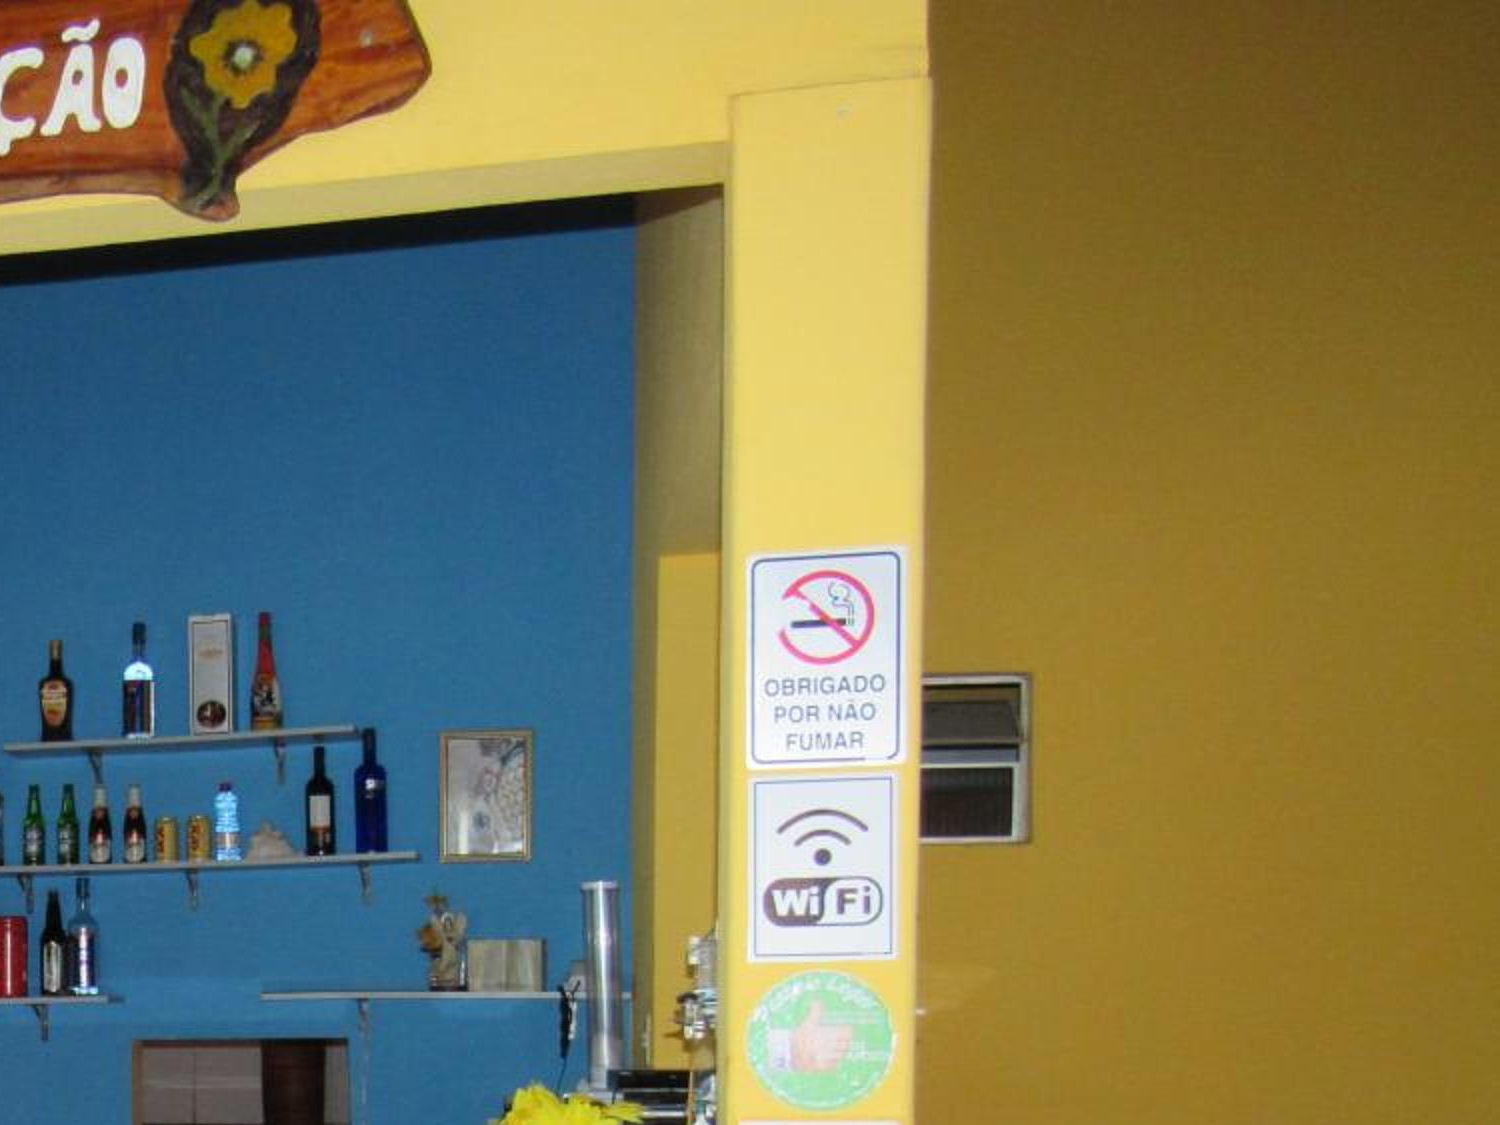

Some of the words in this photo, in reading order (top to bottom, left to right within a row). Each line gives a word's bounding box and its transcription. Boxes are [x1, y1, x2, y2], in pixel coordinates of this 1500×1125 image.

[764, 674, 886, 697] OBRIGADO
[774, 705, 820, 723] POR
[828, 699, 877, 722] NÃO
[786, 731, 864, 751] FUMAR
